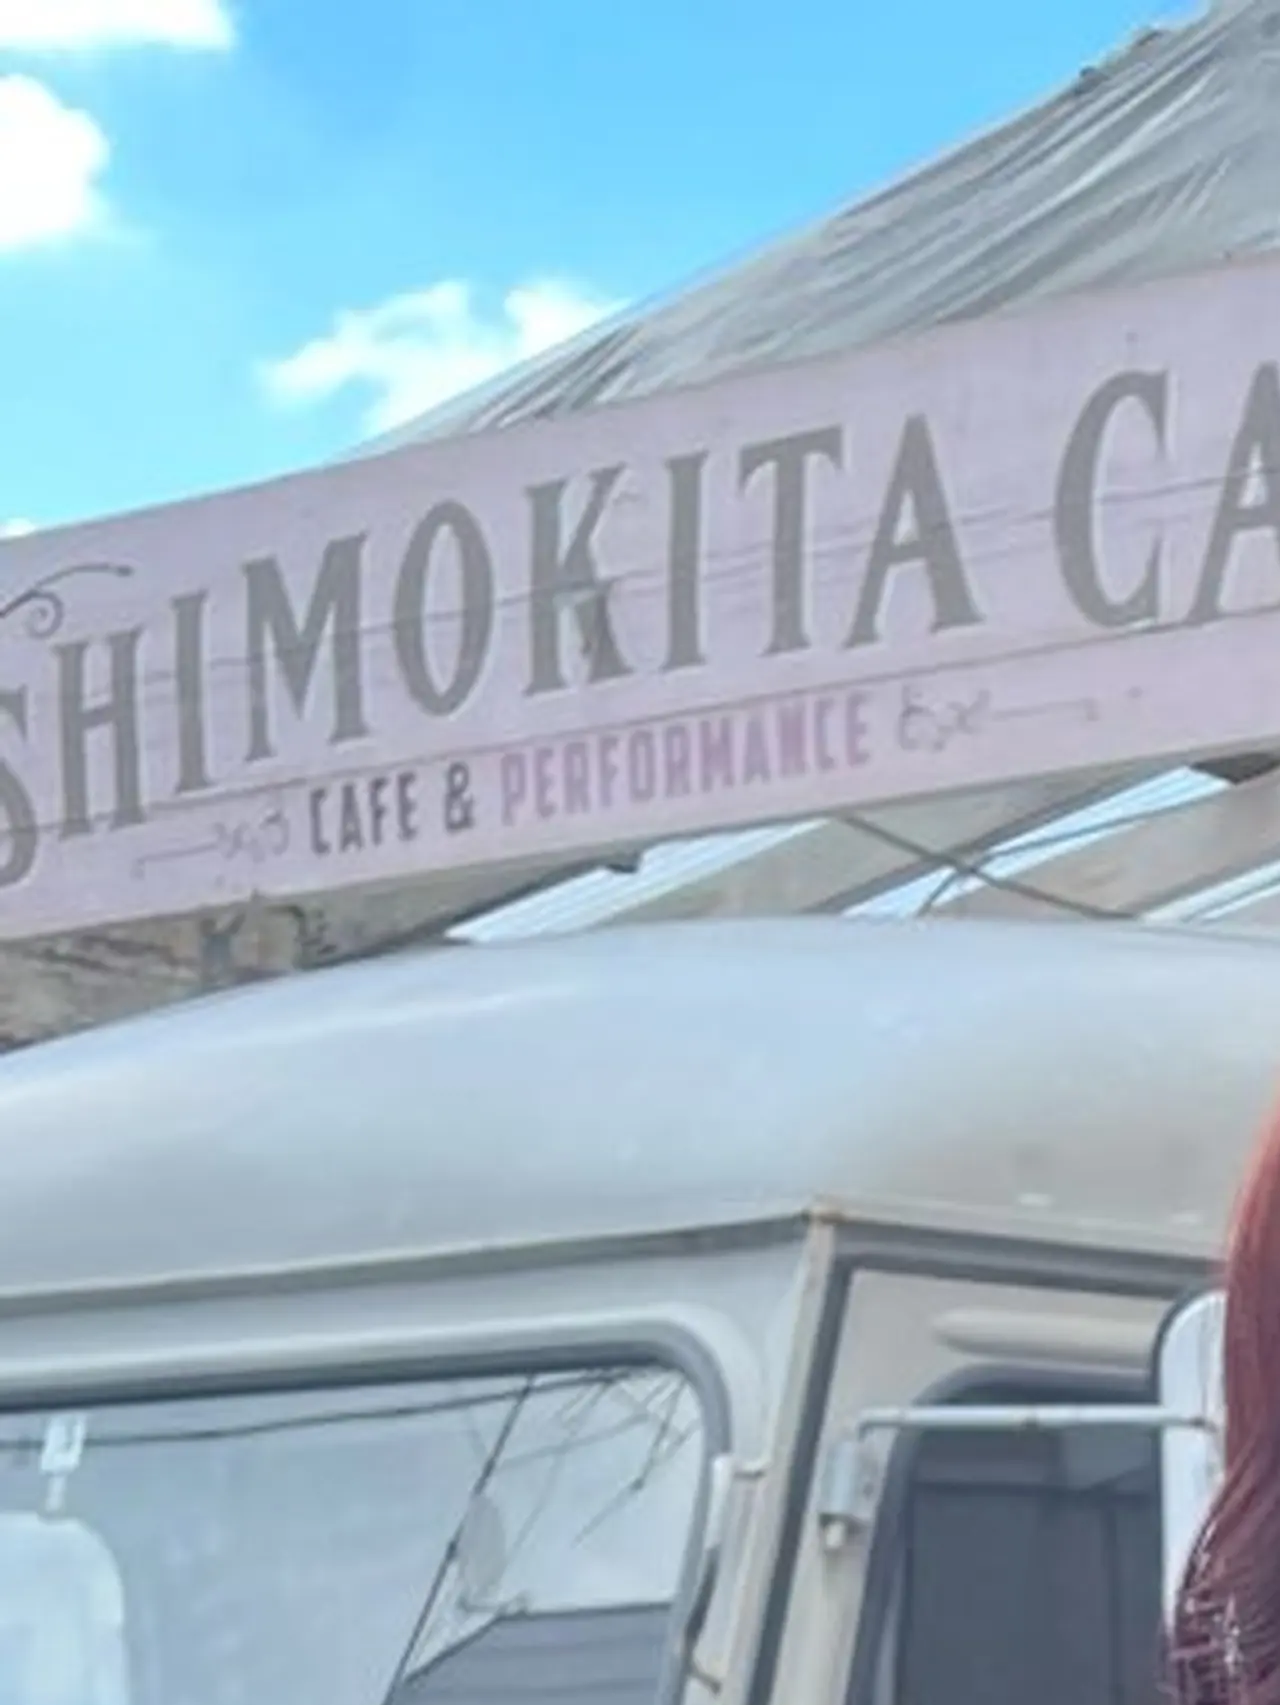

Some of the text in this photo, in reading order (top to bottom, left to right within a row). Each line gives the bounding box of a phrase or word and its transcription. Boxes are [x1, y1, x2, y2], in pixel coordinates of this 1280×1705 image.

[309, 692, 871, 856] CAFE & PERFORMANCE
